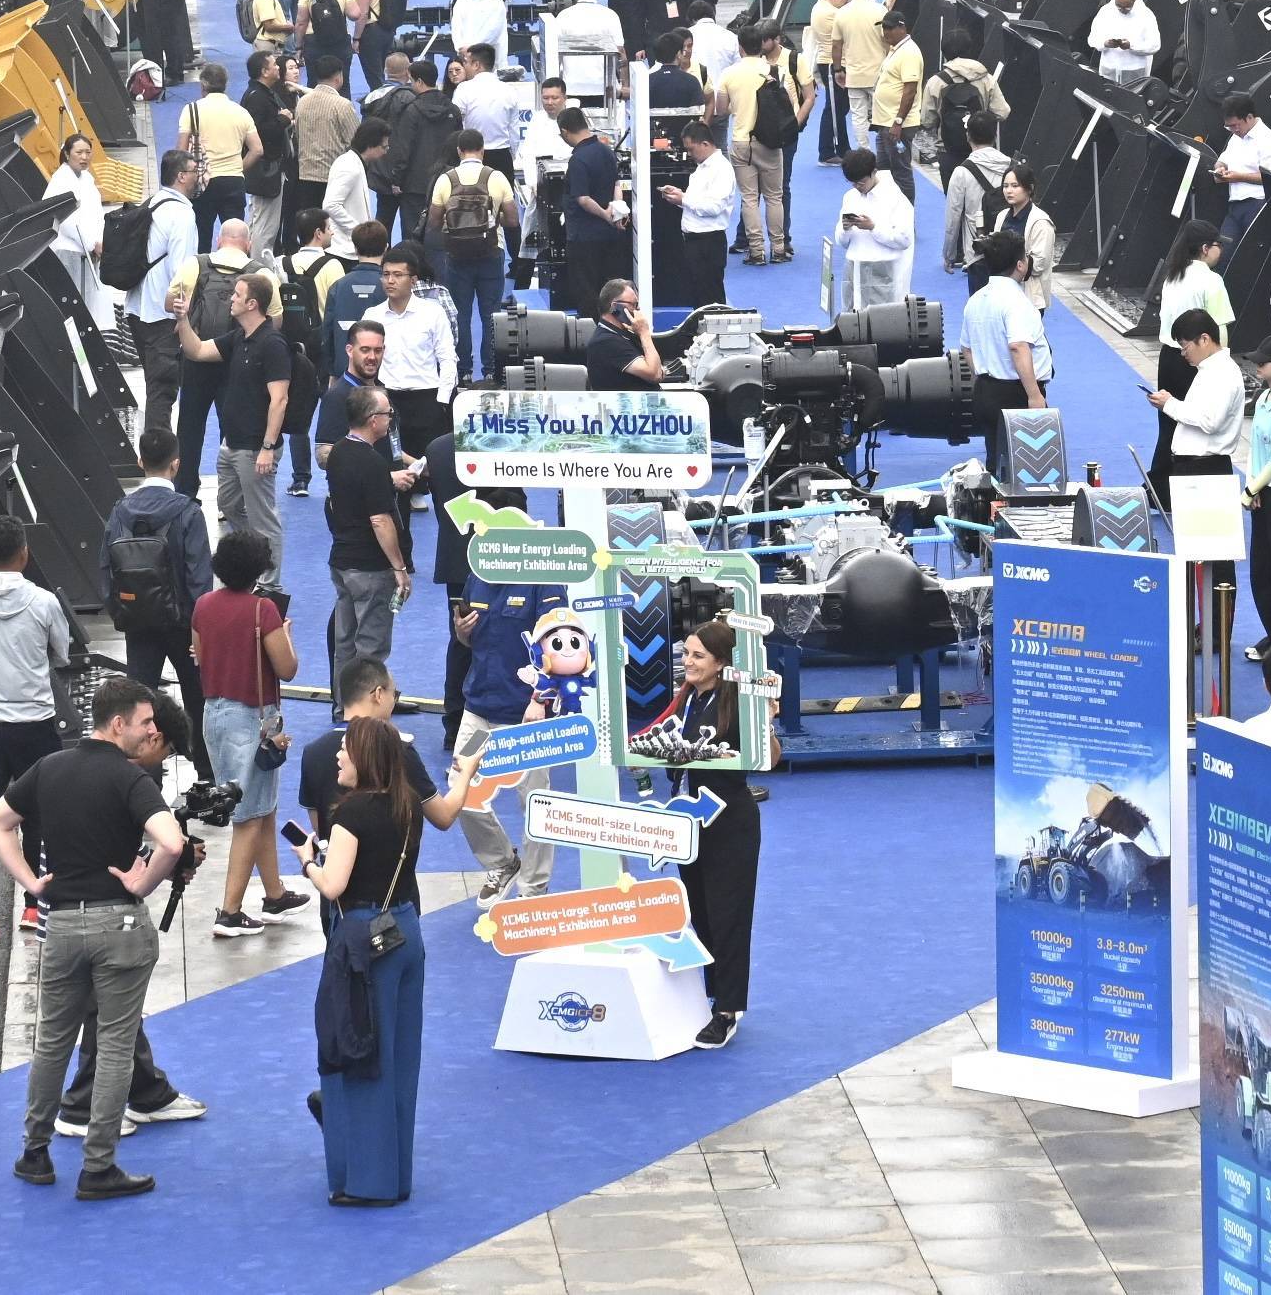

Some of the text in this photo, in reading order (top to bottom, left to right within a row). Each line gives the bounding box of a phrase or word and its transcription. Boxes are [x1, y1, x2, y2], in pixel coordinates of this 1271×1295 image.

[467, 414, 694, 436] I Miss You In XUZHOU
[494, 461, 673, 479] Home Is Where You Are
[478, 542, 587, 557] XCMG New Energy Loading
[478, 558, 588, 572] Machinery Exhibition Area
[625, 557, 651, 566] GREEN
[705, 559, 723, 567] FOR
[1015, 566, 1050, 582] XCMG
[1084, 648, 1139, 663] WHEEL LOADER
[753, 684, 778, 698] ZHOU
[498, 732, 535, 749] High-end
[536, 728, 554, 743] Fuel
[555, 723, 589, 739] Loading
[521, 746, 563, 762] Exhibition
[564, 742, 584, 753] Area
[1211, 757, 1234, 779] XCMG
[545, 809, 675, 839] XCMG Small-size Loading
[545, 822, 678, 852] Machinery Exhibition Area
[501, 892, 680, 926] XCMG Ultra-large Tonnage Loading
[504, 915, 637, 941] Machinery Exhibition Area
[1031, 930, 1072, 948] 11000kg
[1030, 972, 1074, 991] 35000kg
[1100, 984, 1145, 1001] 3250mm
[1030, 1019, 1074, 1036] 3800mm
[1105, 1029, 1140, 1045] 277kW
[1223, 1166, 1250, 1195] 11000kg
[1223, 1218, 1252, 1247] 35000kg
